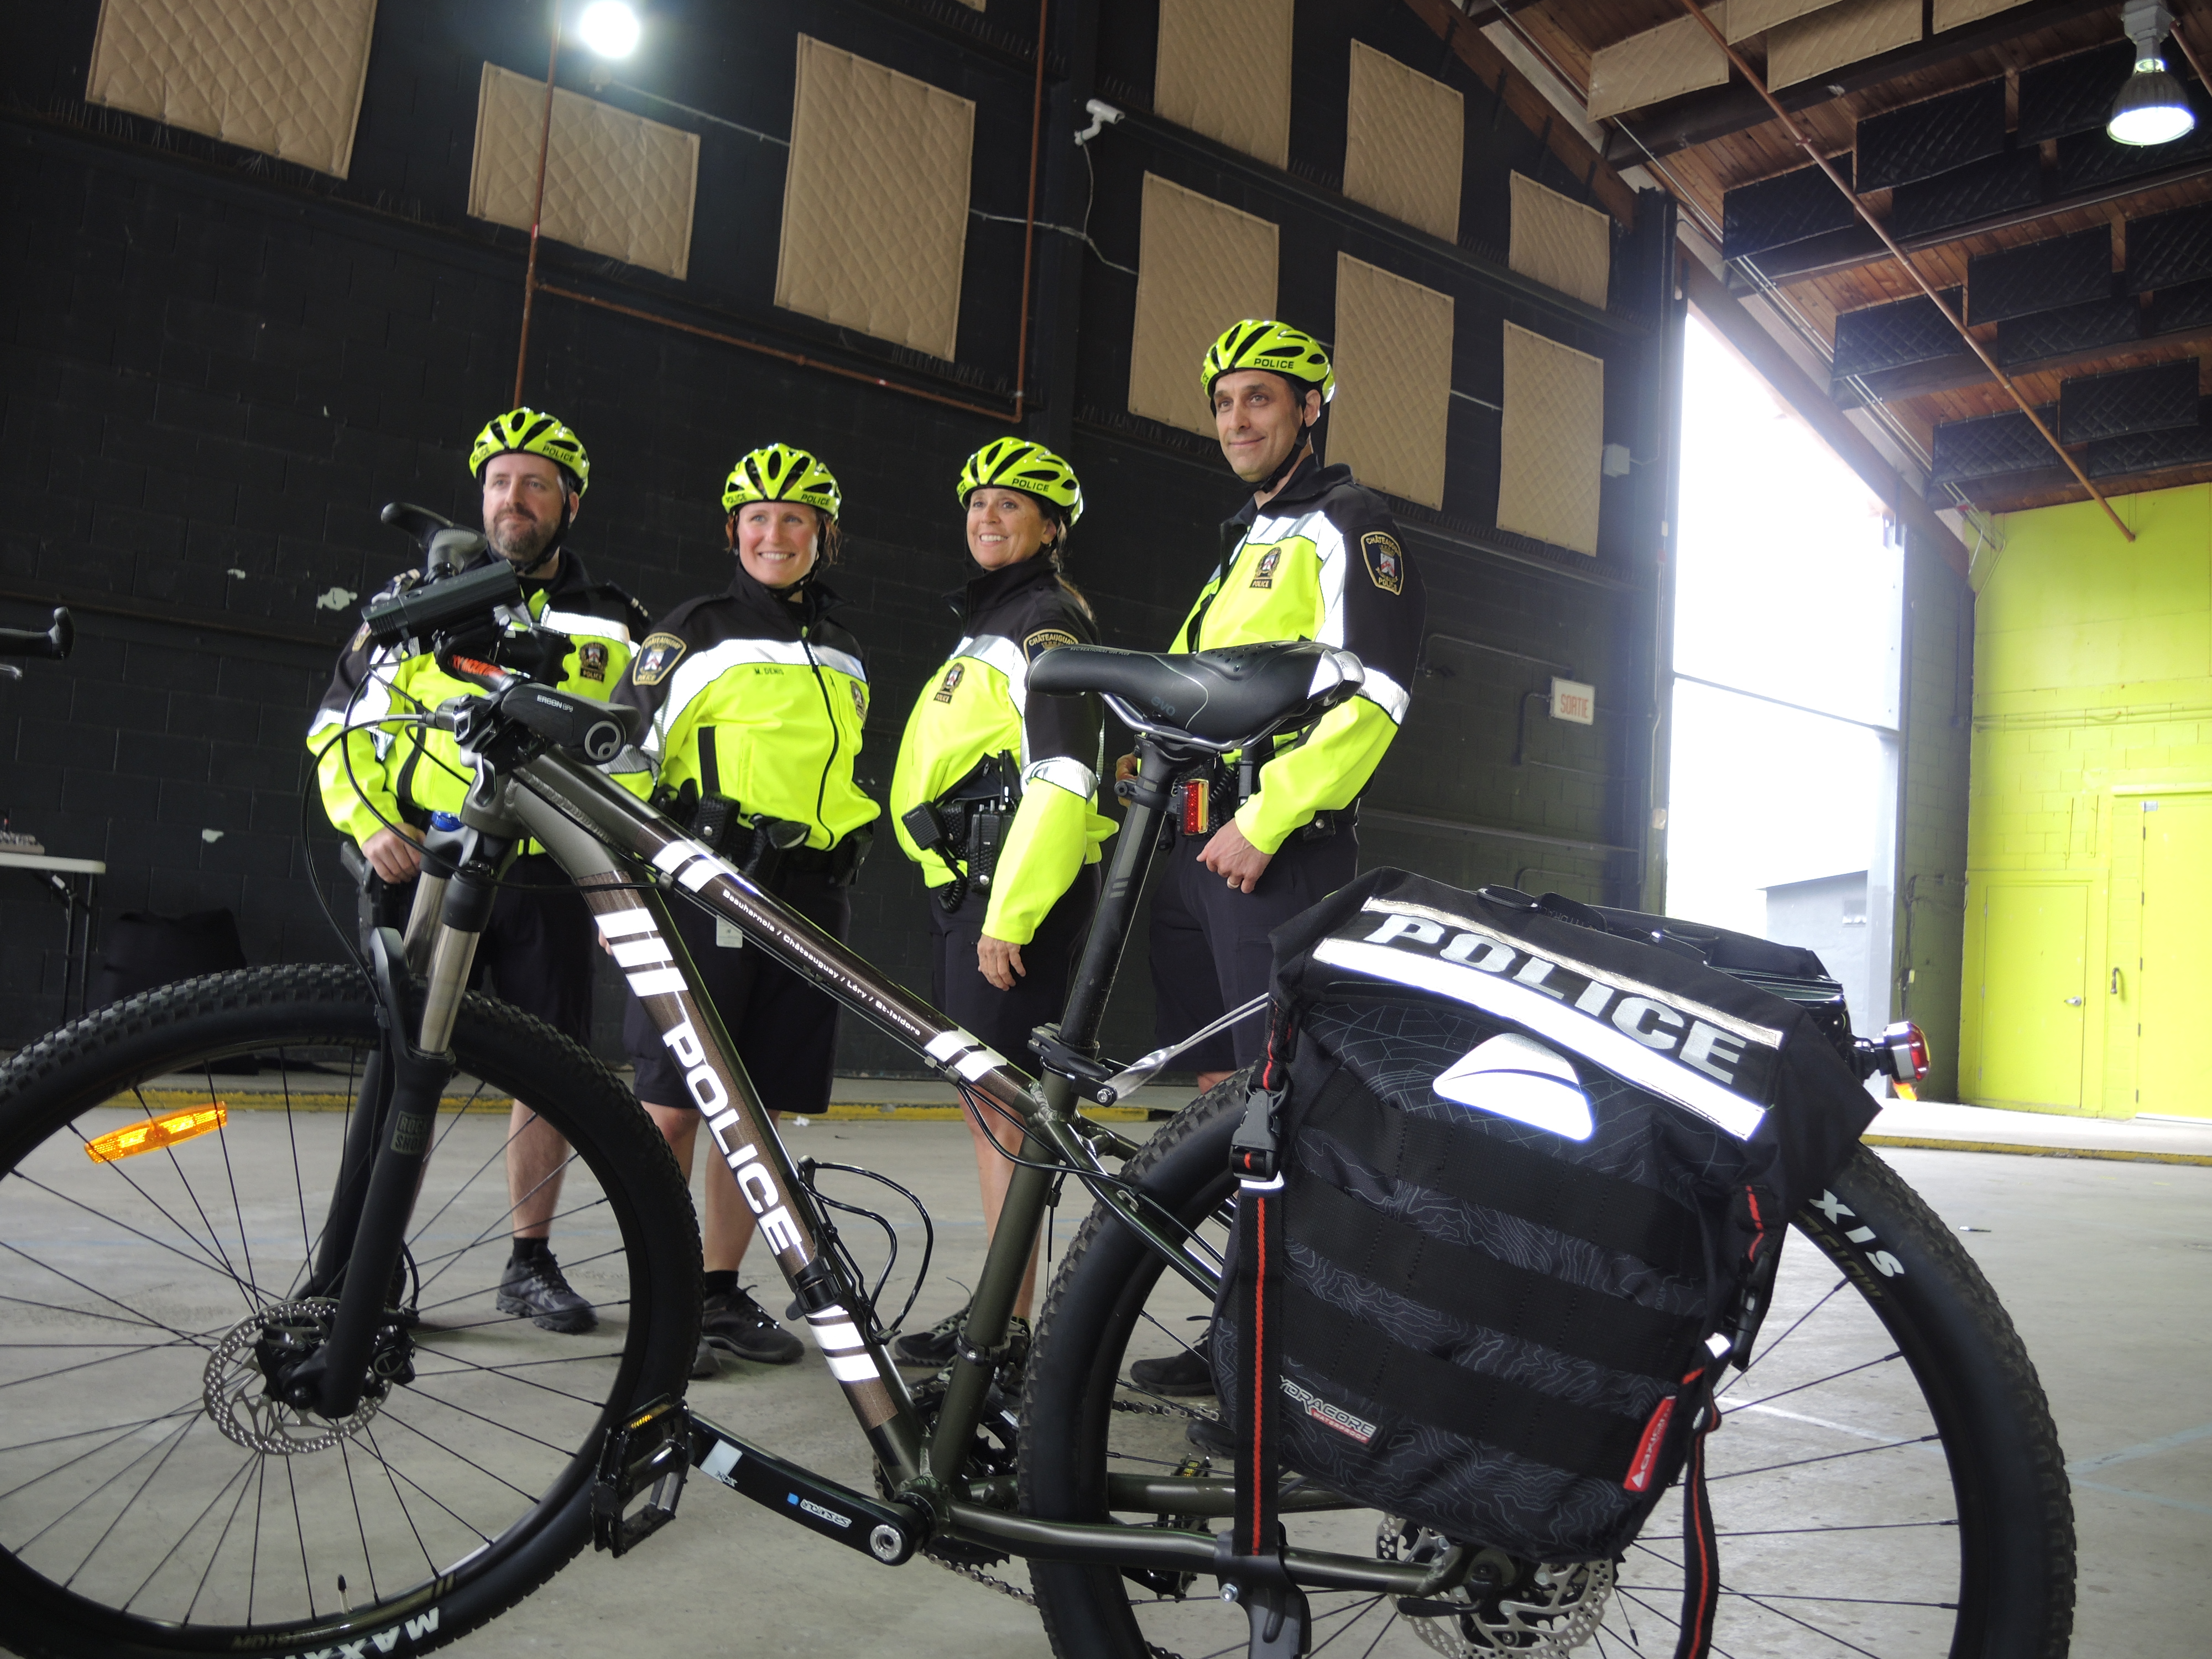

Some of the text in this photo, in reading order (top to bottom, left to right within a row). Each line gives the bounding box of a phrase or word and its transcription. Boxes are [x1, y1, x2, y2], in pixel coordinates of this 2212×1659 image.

[1254, 358, 1294, 369] POLICE
[542, 445, 574, 463] POLICE
[1012, 478, 1050, 492] POLICE
[801, 493, 830, 505] POLICE
[583, 670, 602, 681] POLICE
[1151, 696, 1176, 717] evo
[1560, 693, 1589, 718] SORTIE
[1363, 914, 1747, 1084] POLICE
[663, 1021, 802, 1255] POLICE
[1808, 1188, 1905, 1277] XIS
[1313, 1411, 1368, 1442] WATERPROOF
[260, 1606, 440, 1659] MAXX
